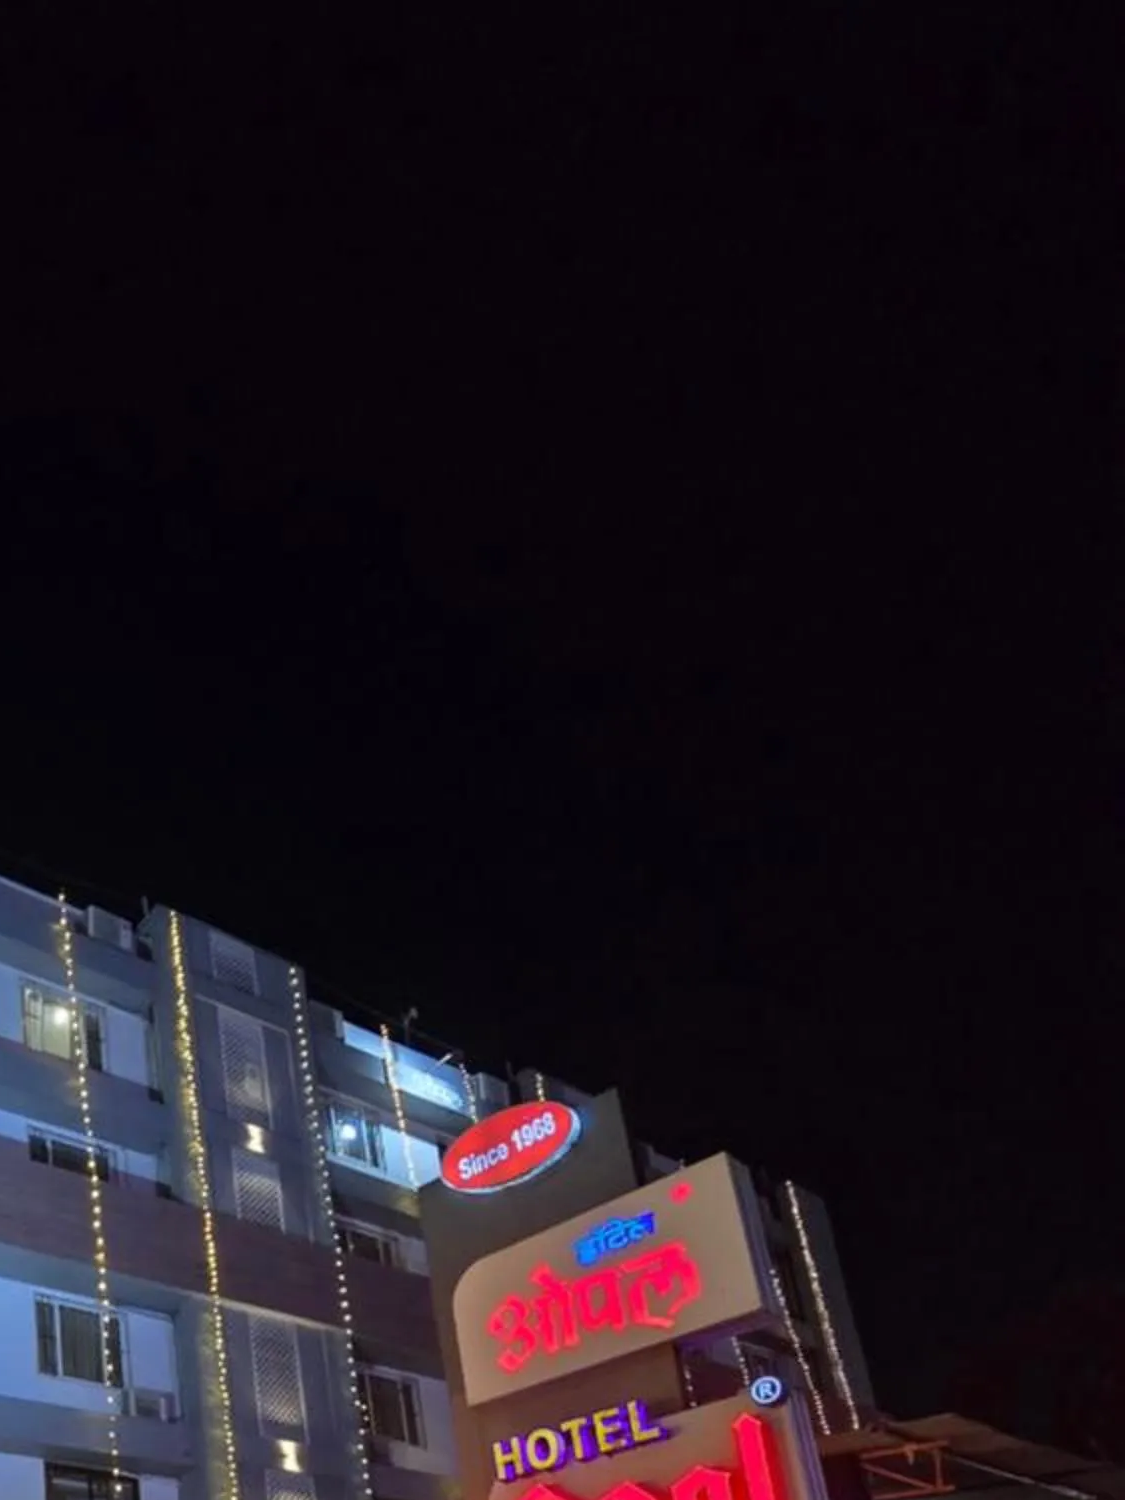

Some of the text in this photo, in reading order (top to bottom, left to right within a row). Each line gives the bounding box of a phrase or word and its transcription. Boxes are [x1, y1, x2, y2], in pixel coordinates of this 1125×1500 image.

[458, 1111, 556, 1180] Since 1968
[488, 1241, 702, 1374] ओपल
[492, 1400, 663, 1482] HOTEL
